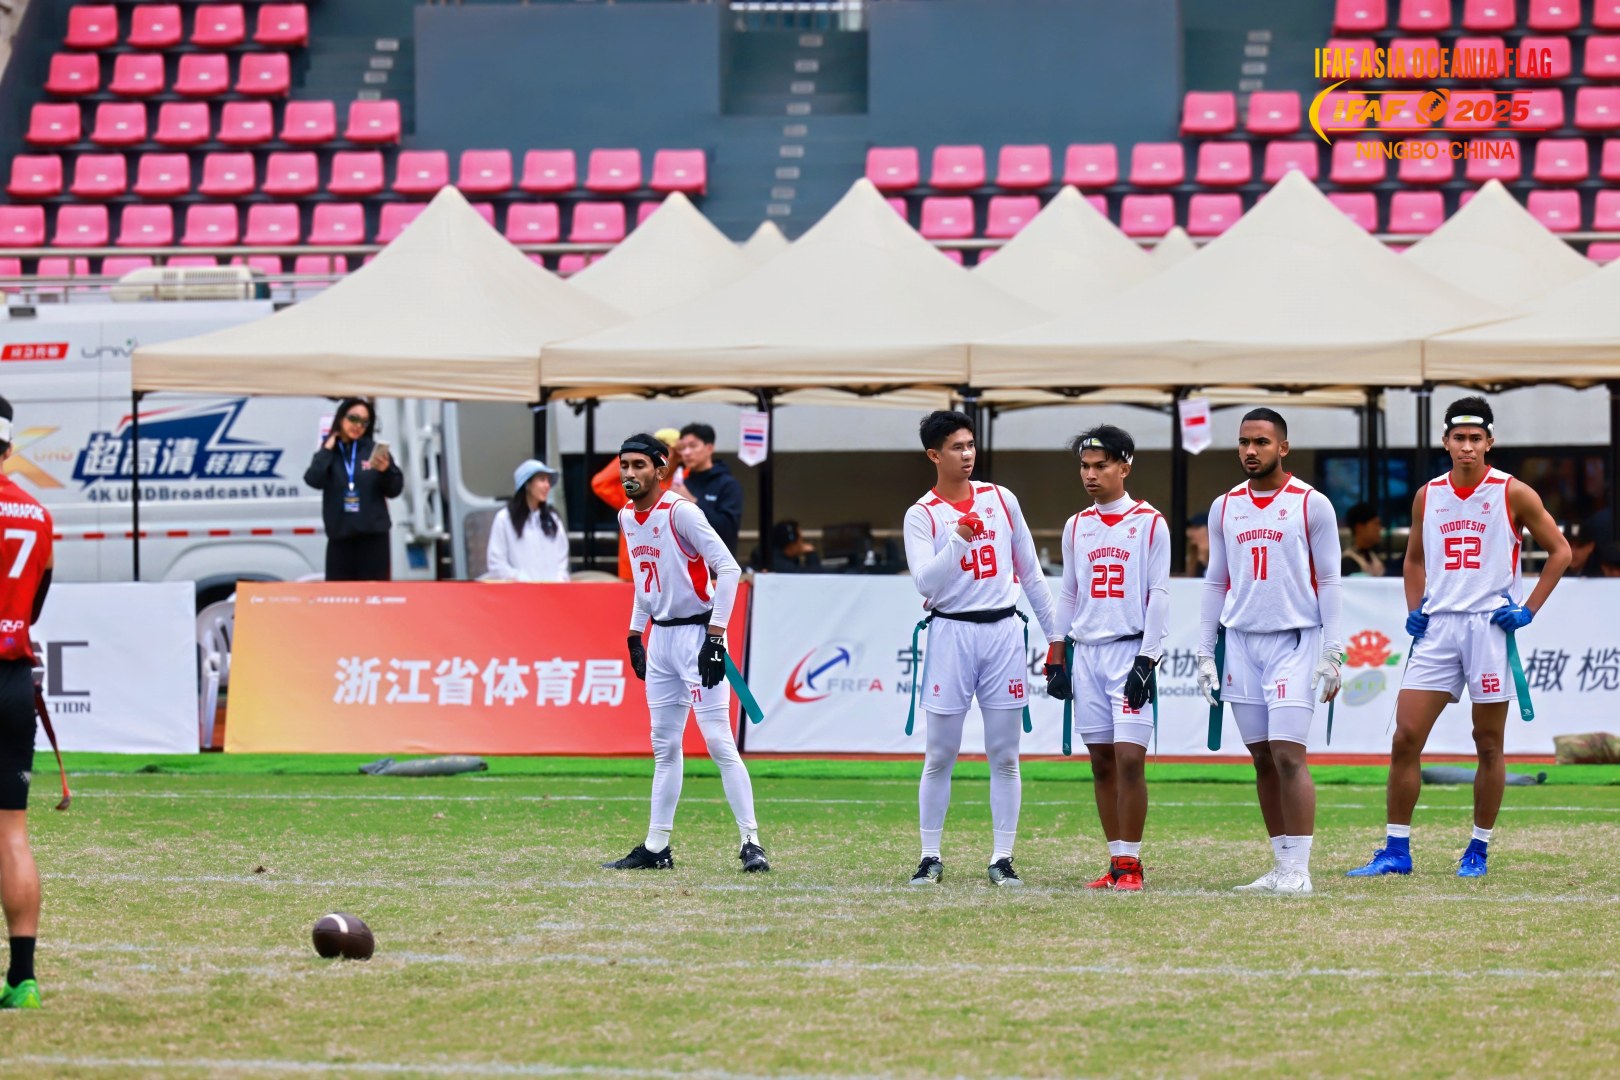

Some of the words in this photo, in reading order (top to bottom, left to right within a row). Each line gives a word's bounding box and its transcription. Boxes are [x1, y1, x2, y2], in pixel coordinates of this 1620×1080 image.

[82, 433, 199, 477] 超高清
[204, 452, 274, 475] 转播车
[88, 488, 112, 502] 4K
[263, 485, 299, 498] Van
[1440, 519, 1487, 535] INDONESIA
[1236, 528, 1284, 545] INDONESIA
[4, 528, 37, 578] 7
[631, 545, 661, 559] INDONESIA
[1087, 546, 1131, 563] INDONESIA
[1444, 536, 1482, 571] 52
[960, 544, 998, 580] 49
[1251, 546, 1267, 581] 11
[639, 561, 662, 593] 71
[1090, 564, 1125, 598] 22
[332, 656, 627, 707] 浙江省体育局
[827, 677, 884, 692] FRFA
[1482, 678, 1501, 693] 52
[690, 688, 702, 703] 71
[1008, 683, 1024, 699] 49
[1277, 684, 1286, 699] 11
[52, 701, 92, 714] TION
